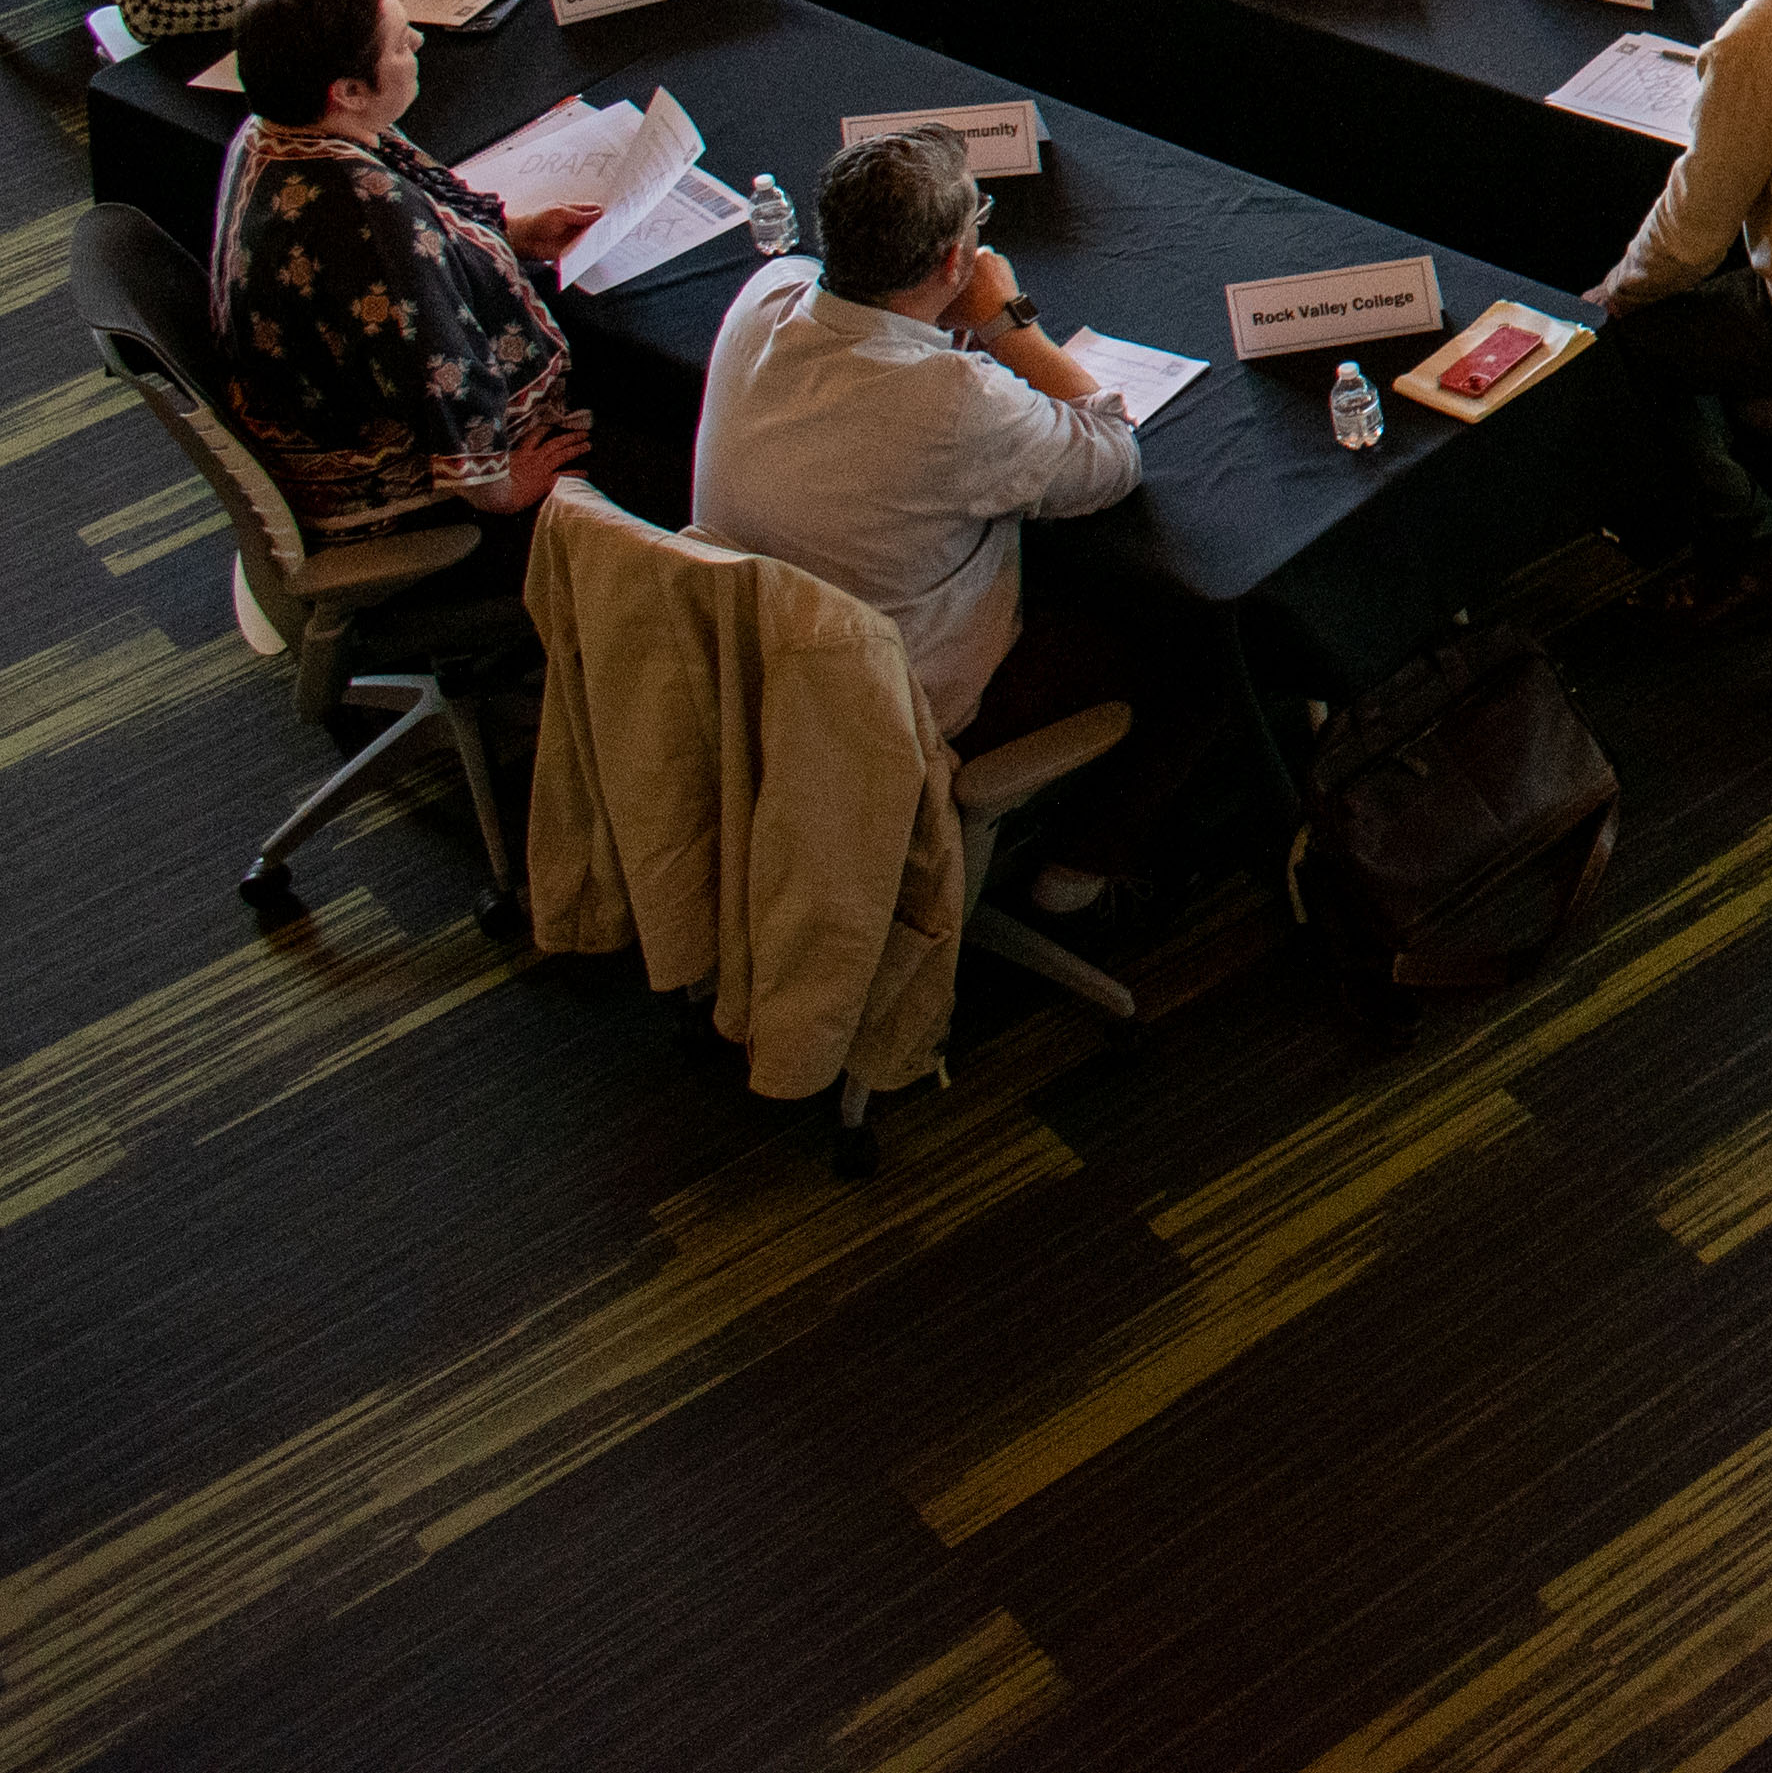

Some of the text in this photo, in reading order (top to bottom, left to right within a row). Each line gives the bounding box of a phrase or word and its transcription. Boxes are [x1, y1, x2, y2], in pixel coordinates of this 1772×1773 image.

[517, 152, 620, 175] DRAFT
[1252, 291, 1414, 326] Rock Valley College
